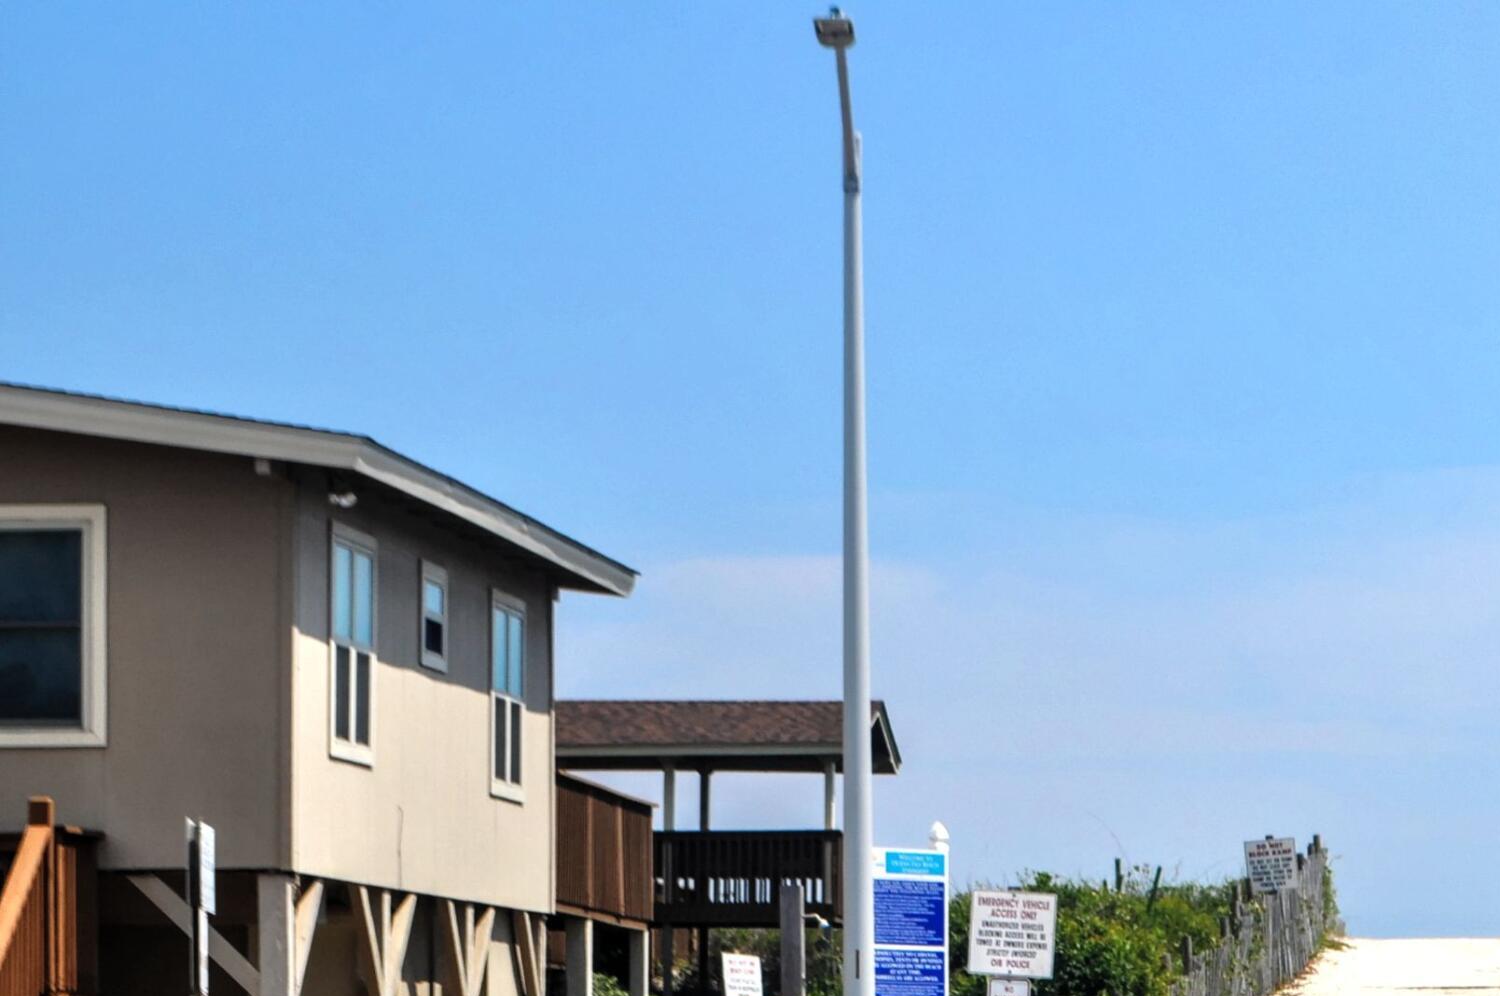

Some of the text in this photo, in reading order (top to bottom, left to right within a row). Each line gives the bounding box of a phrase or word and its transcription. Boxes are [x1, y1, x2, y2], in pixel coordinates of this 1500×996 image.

[978, 896, 1050, 911] EMERGENCY VEHICLE
[991, 909, 1037, 920] ACCESS ONLY
[1006, 960, 1030, 969] POLICE
